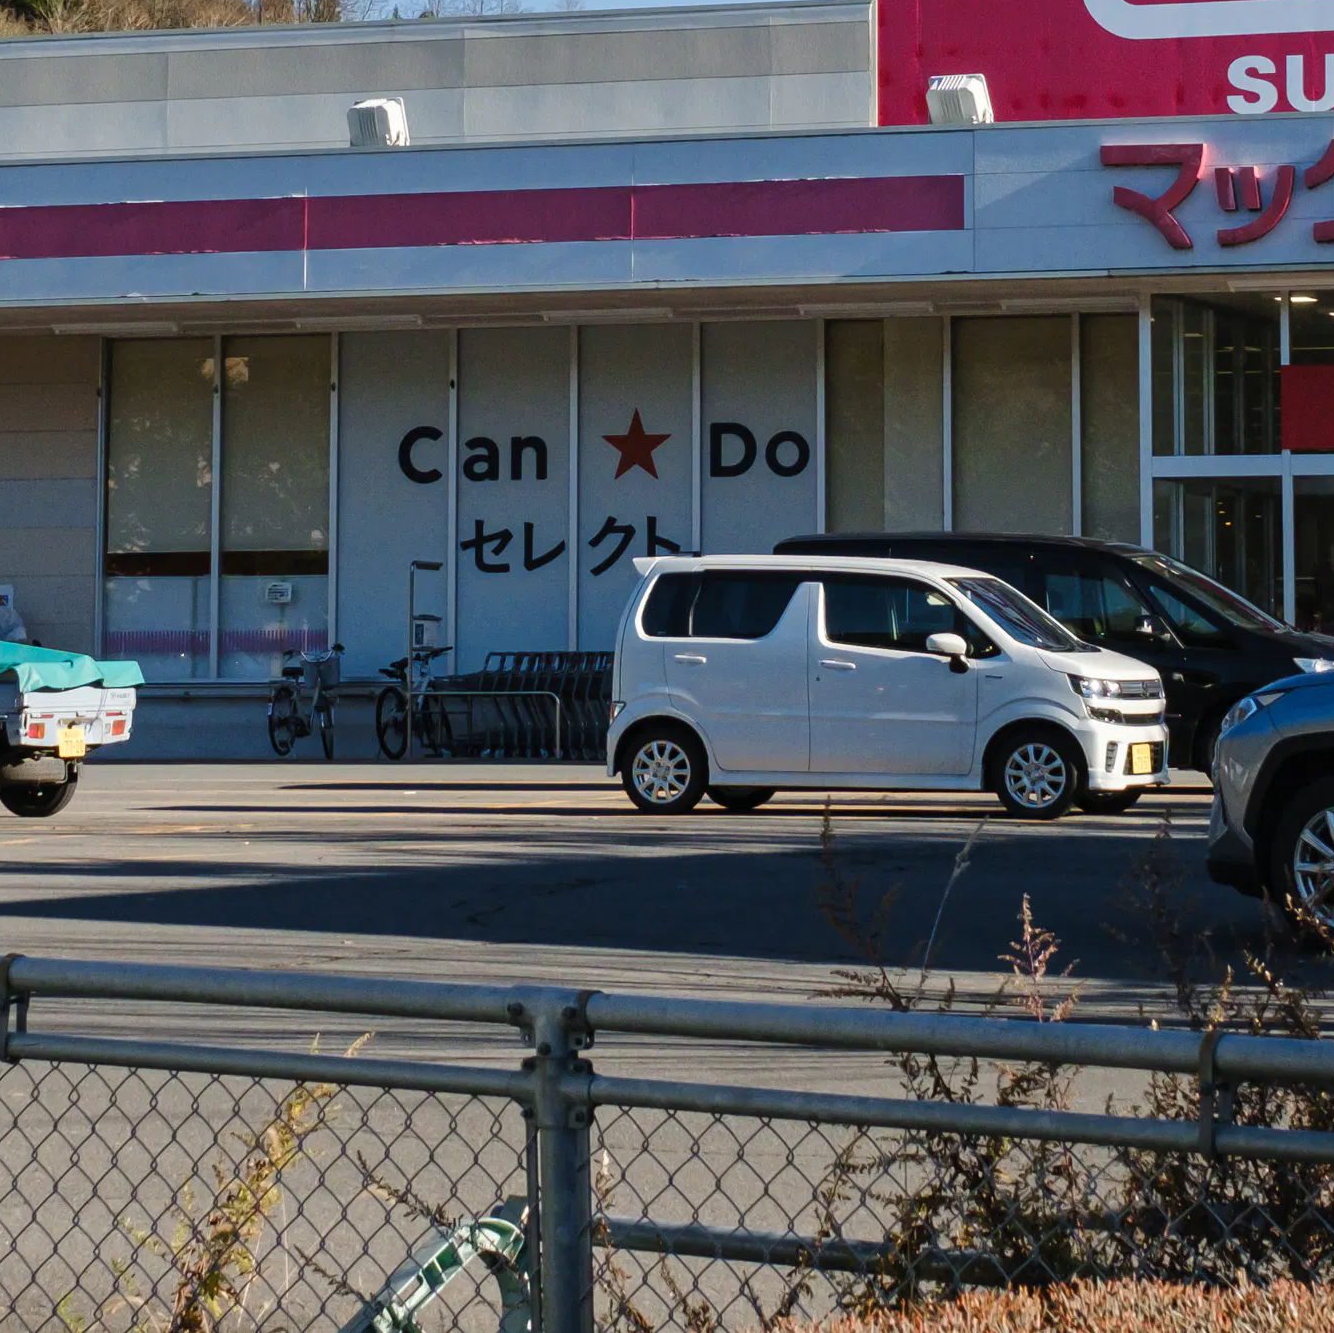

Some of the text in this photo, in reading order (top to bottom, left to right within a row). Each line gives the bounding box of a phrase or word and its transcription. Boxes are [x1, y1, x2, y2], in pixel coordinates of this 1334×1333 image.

[398, 422, 810, 485] Can Do
[460, 515, 681, 575] セレクト
